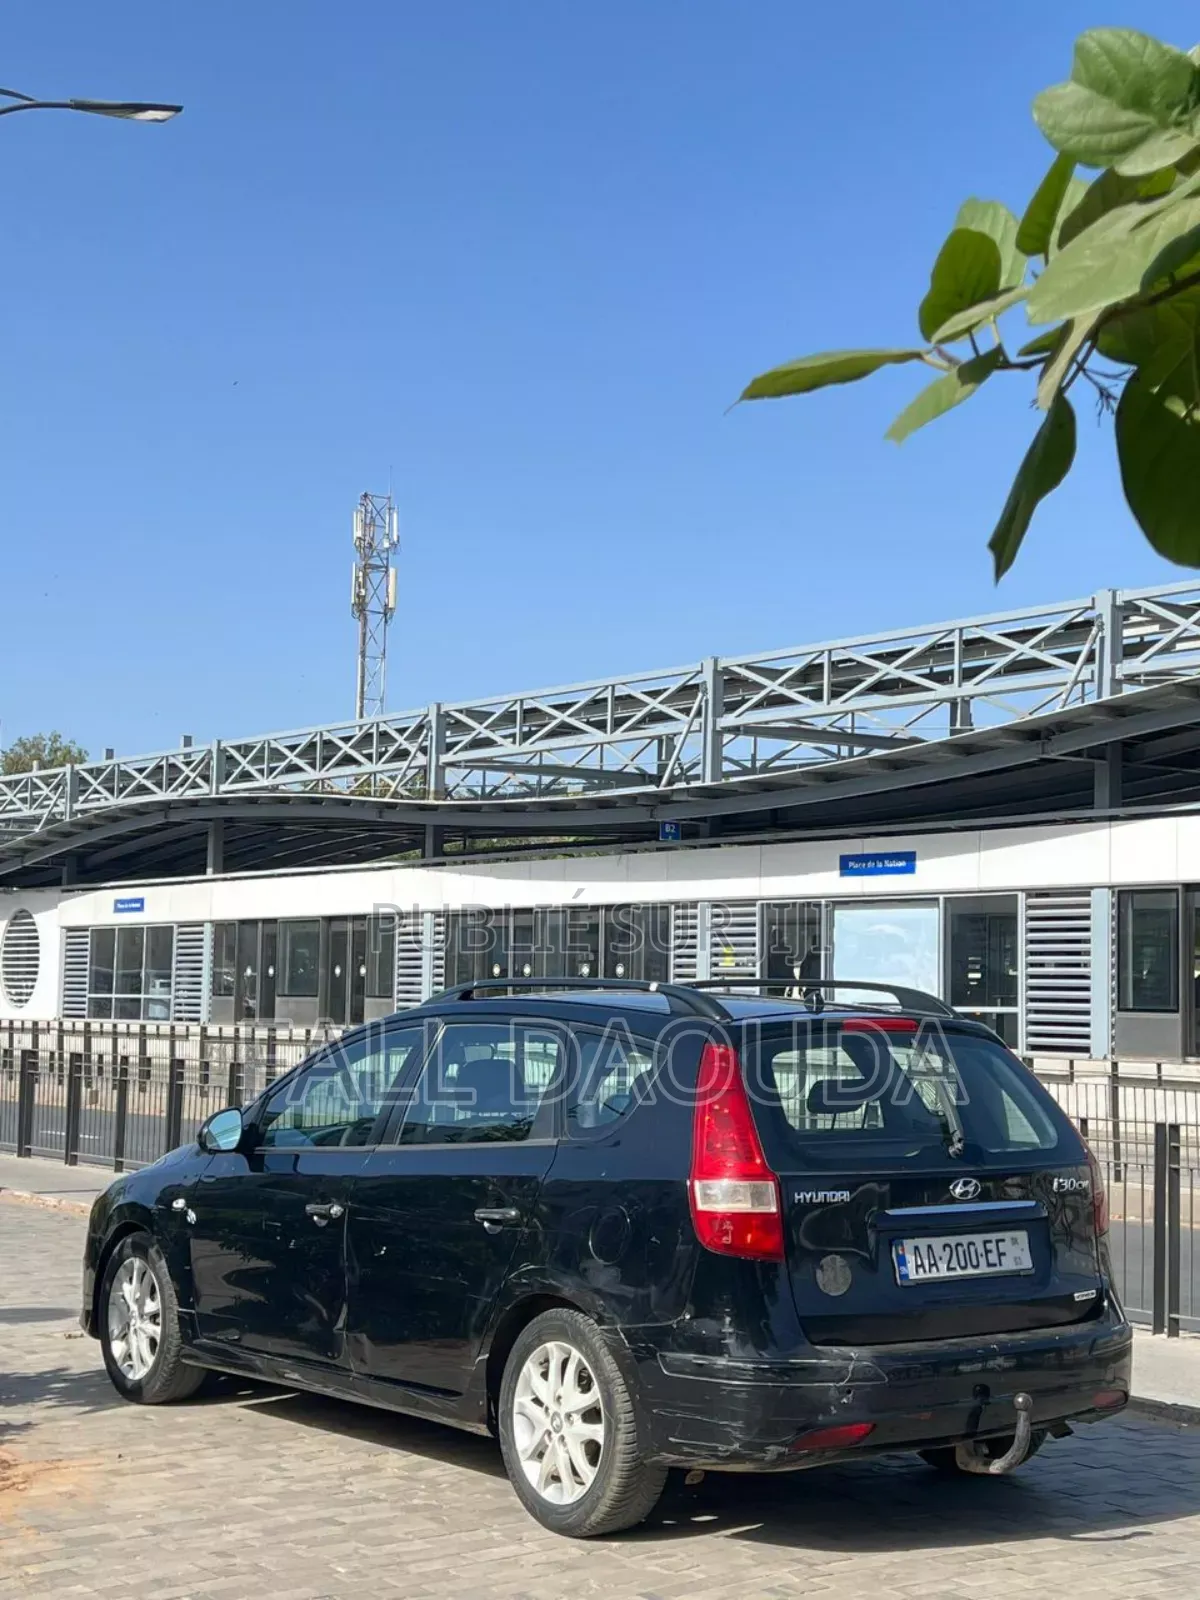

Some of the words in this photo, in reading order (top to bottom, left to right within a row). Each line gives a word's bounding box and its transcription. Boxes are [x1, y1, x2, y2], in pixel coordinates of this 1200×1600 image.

[848, 861, 866, 869] Place
[867, 860, 875, 868] de
[876, 860, 883, 868] la
[884, 859, 907, 868] Nation
[794, 1190, 850, 1204] HYUNDAI
[913, 1238, 1006, 1275] AA-200-EF
